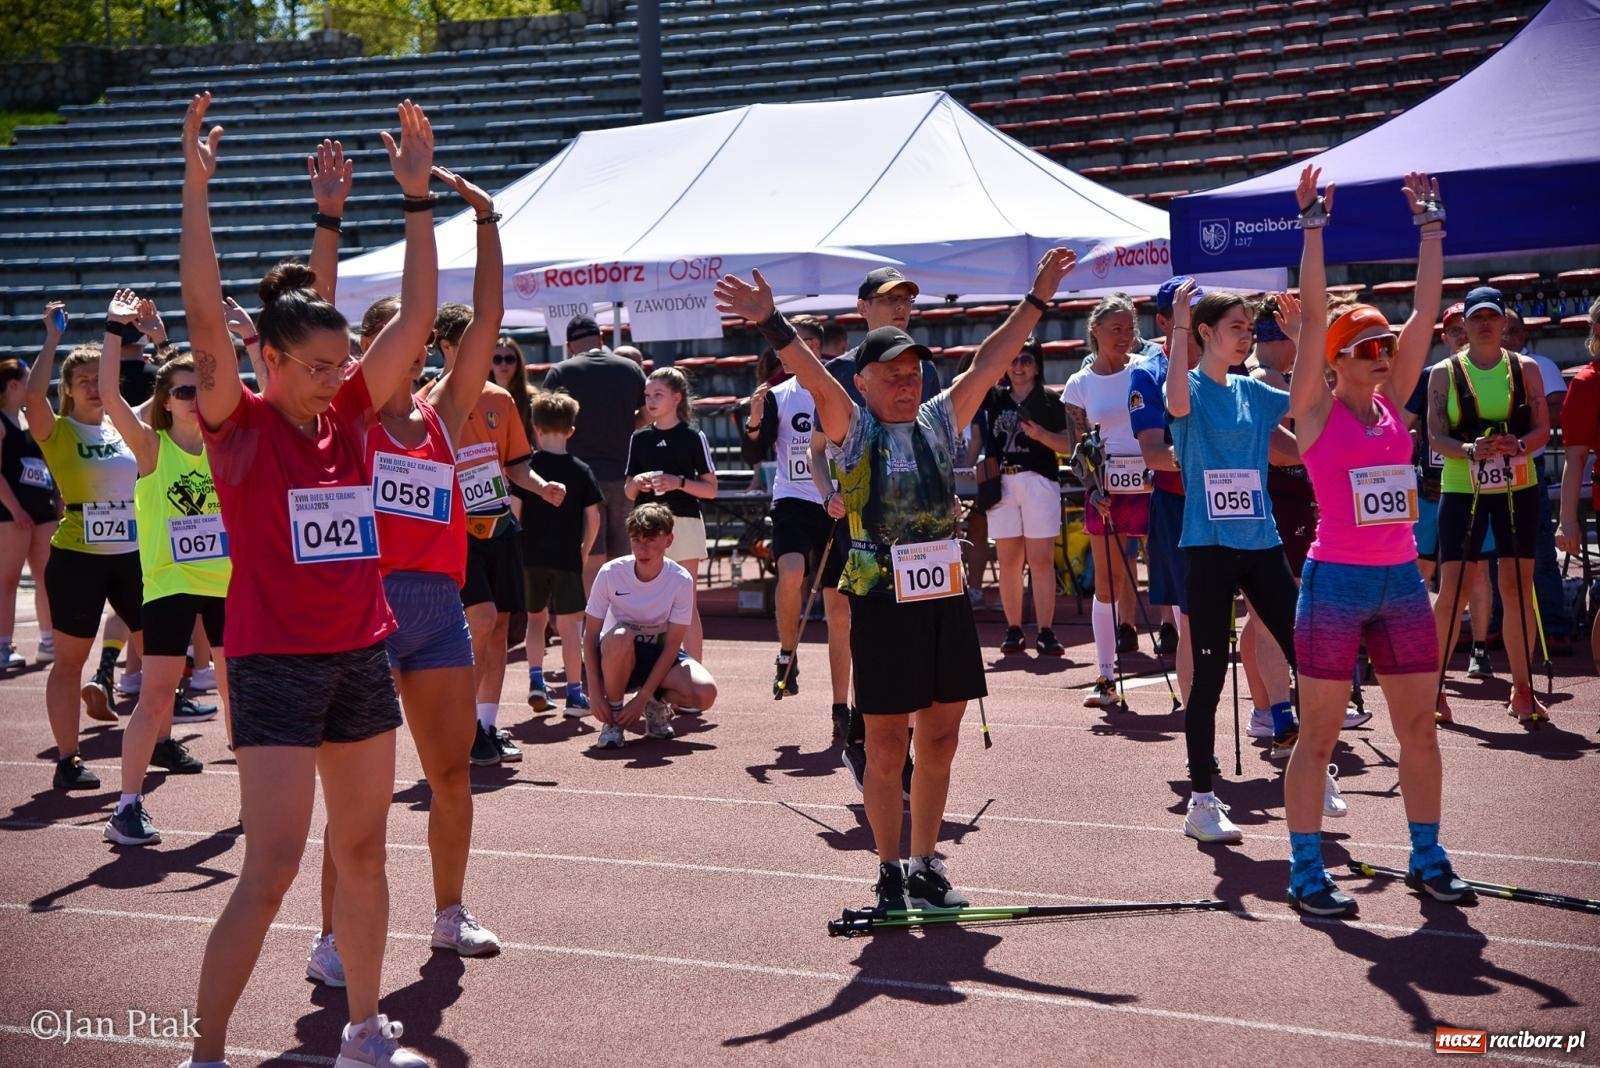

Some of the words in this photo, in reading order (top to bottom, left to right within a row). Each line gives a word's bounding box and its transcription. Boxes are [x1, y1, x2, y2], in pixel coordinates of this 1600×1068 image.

[1235, 218, 1301, 235] Racibórz
[1235, 237, 1252, 247] 1217
[543, 262, 646, 288] Racibórz
[669, 257, 723, 281] OSiR
[548, 302, 589, 319] BIURO
[633, 294, 708, 313] ZAWODÓW
[464, 480, 494, 501] 004
[1110, 473, 1142, 487] 086
[381, 479, 430, 509] 058
[1214, 491, 1251, 510] 056
[1363, 491, 1407, 515] 098
[92, 521, 127, 537] 074
[303, 518, 358, 549] 042
[179, 534, 217, 554] 067
[906, 566, 945, 591] 100
